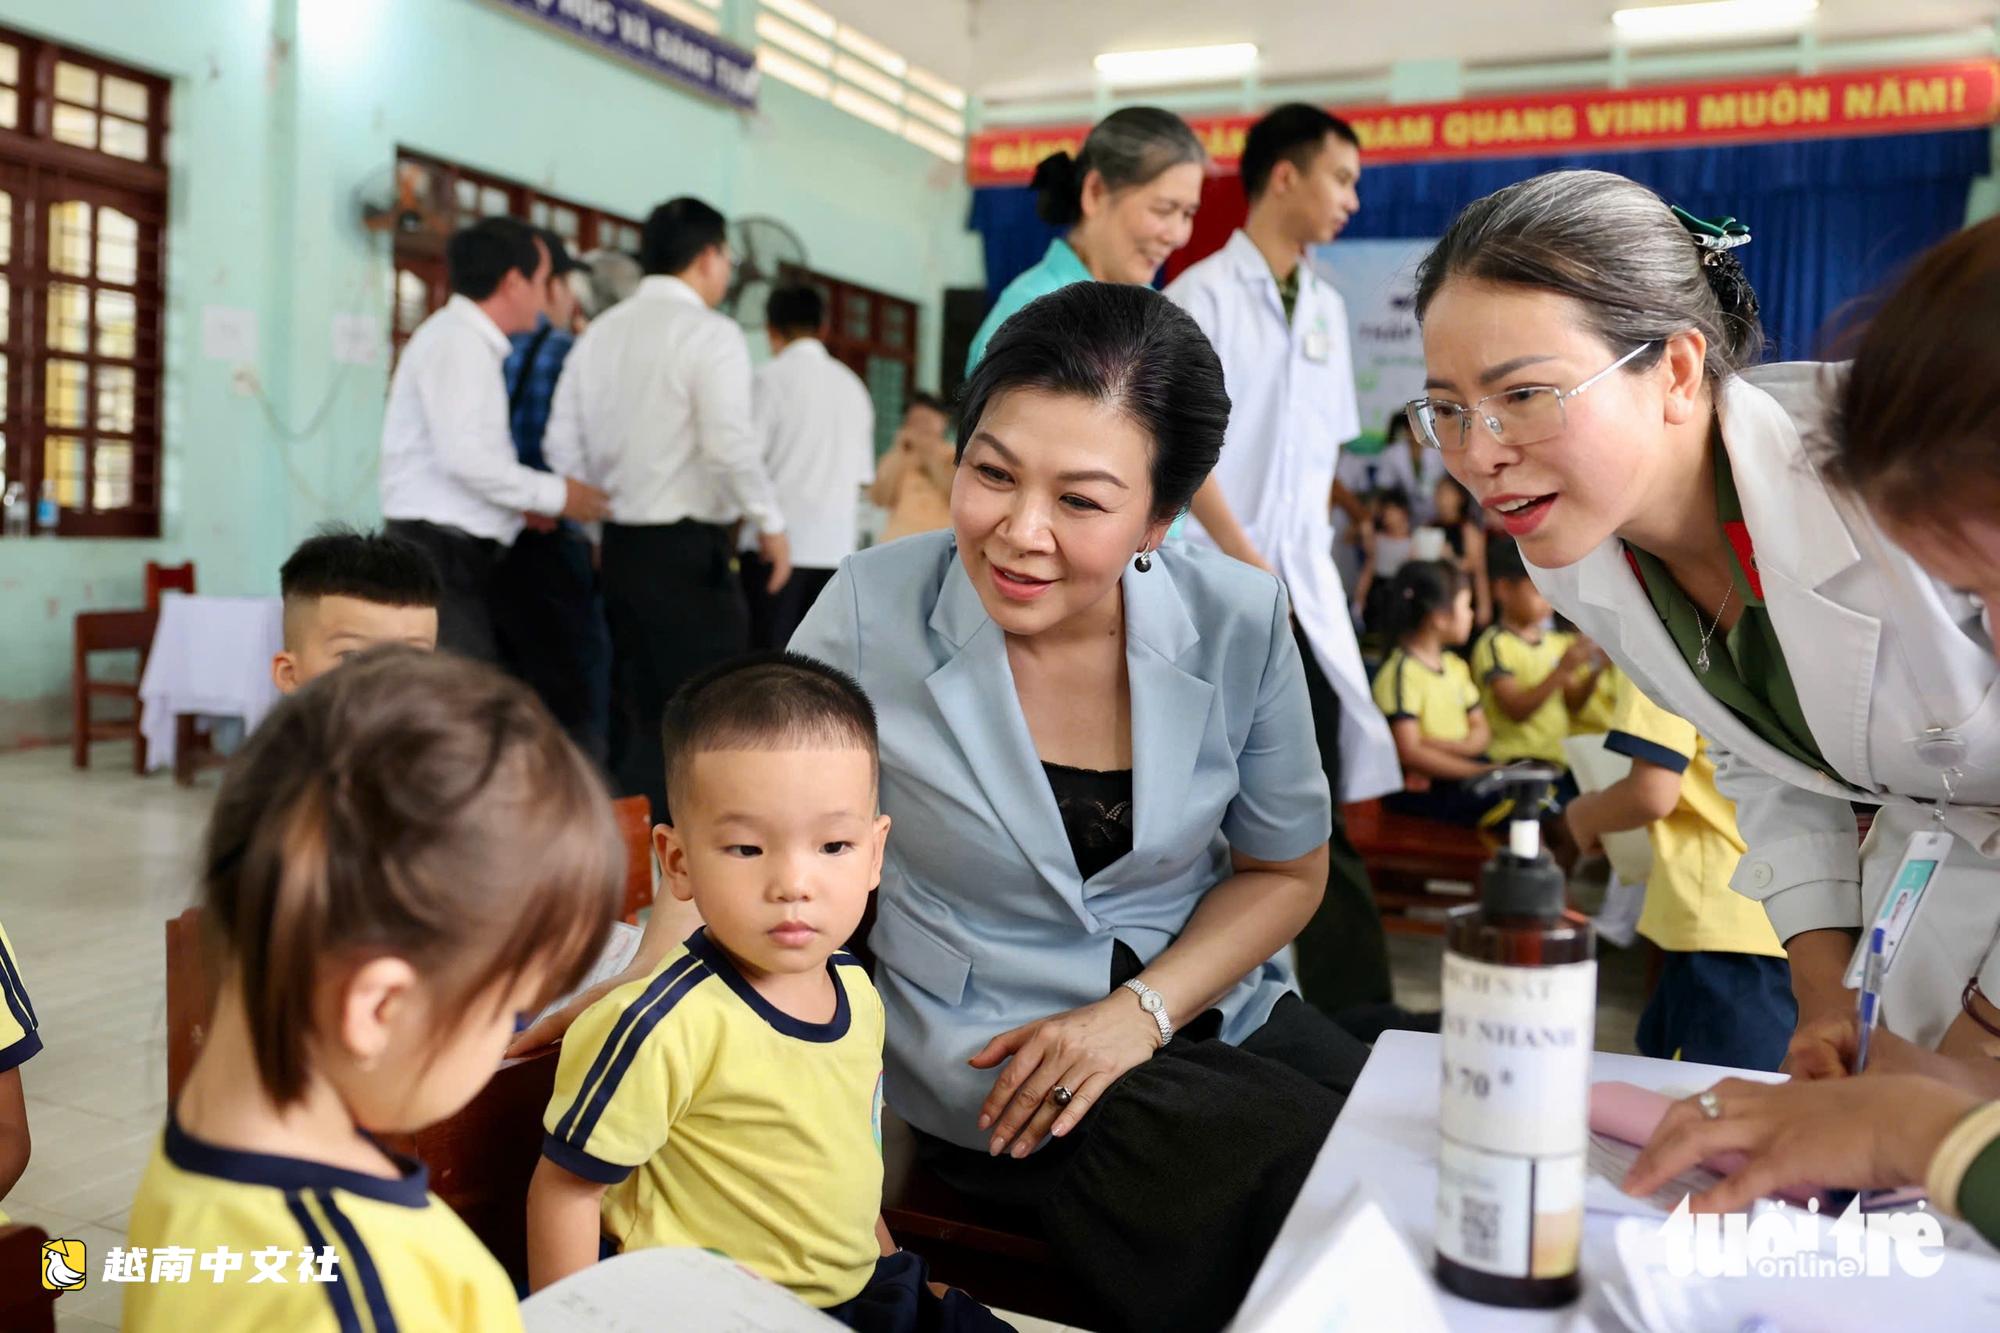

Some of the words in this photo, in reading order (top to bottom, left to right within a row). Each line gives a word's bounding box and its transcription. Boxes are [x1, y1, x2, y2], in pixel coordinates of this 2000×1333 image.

[1442, 104, 1577, 148] QUANG
[1586, 96, 1687, 137] VINH
[1698, 80, 1831, 130] MUÔN
[1842, 75, 1967, 120] NĂM!
[1476, 1019, 1577, 1048] NHANH
